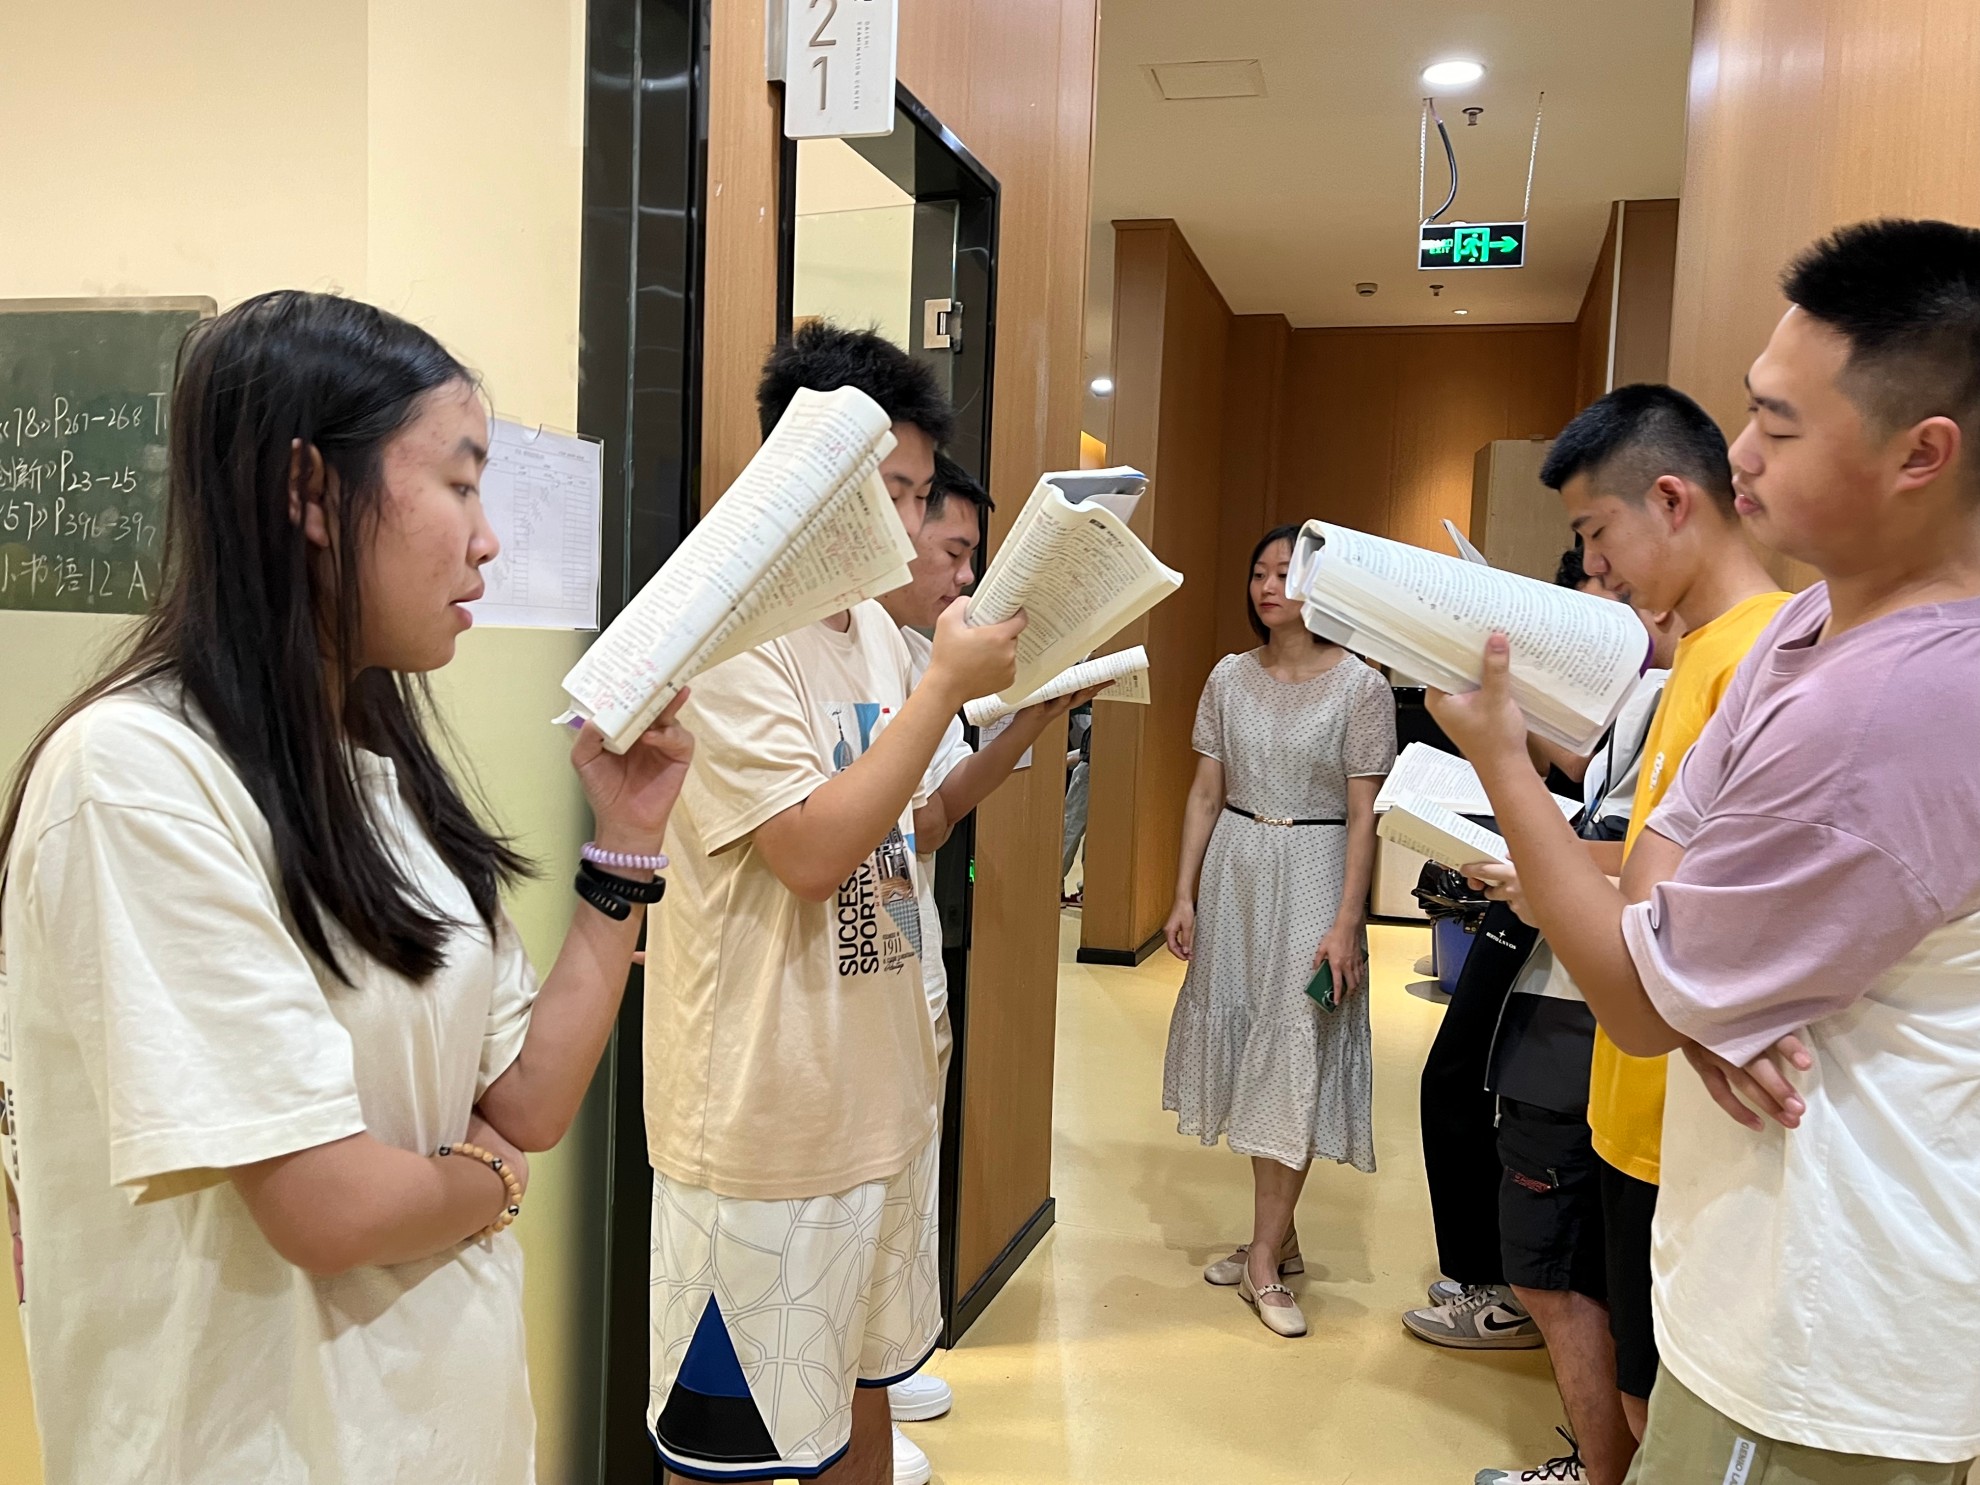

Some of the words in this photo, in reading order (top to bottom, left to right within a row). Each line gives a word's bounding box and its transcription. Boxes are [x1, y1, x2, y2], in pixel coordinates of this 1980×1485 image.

[1429, 246, 1451, 255] EXIT
[838, 869, 859, 977] SUCCES
[883, 936, 902, 957] 1911
